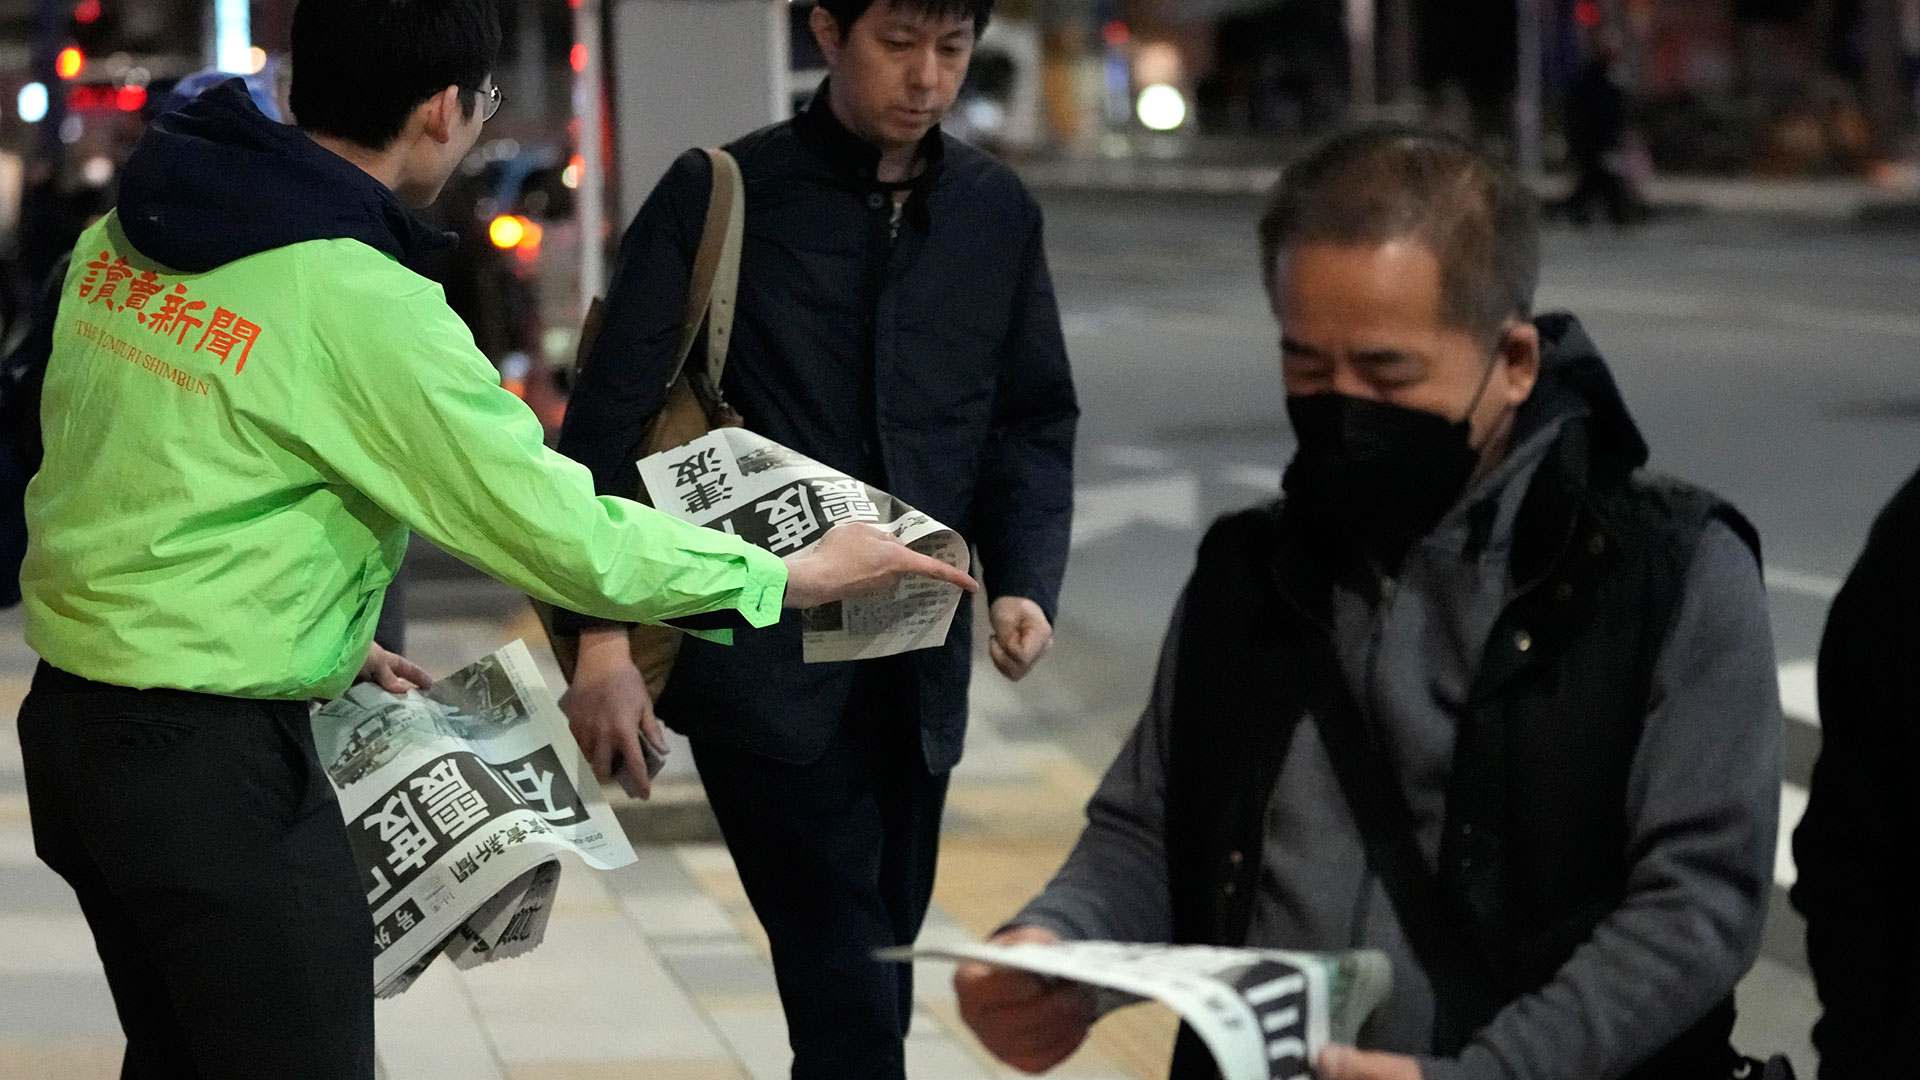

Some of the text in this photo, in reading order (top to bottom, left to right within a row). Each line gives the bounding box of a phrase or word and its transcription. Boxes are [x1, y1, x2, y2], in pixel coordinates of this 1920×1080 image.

[76, 320, 98, 341] THE
[142, 354, 211, 396] SHIMBUN
[667, 447, 733, 514] 津波
[722, 479, 881, 553] 震度
